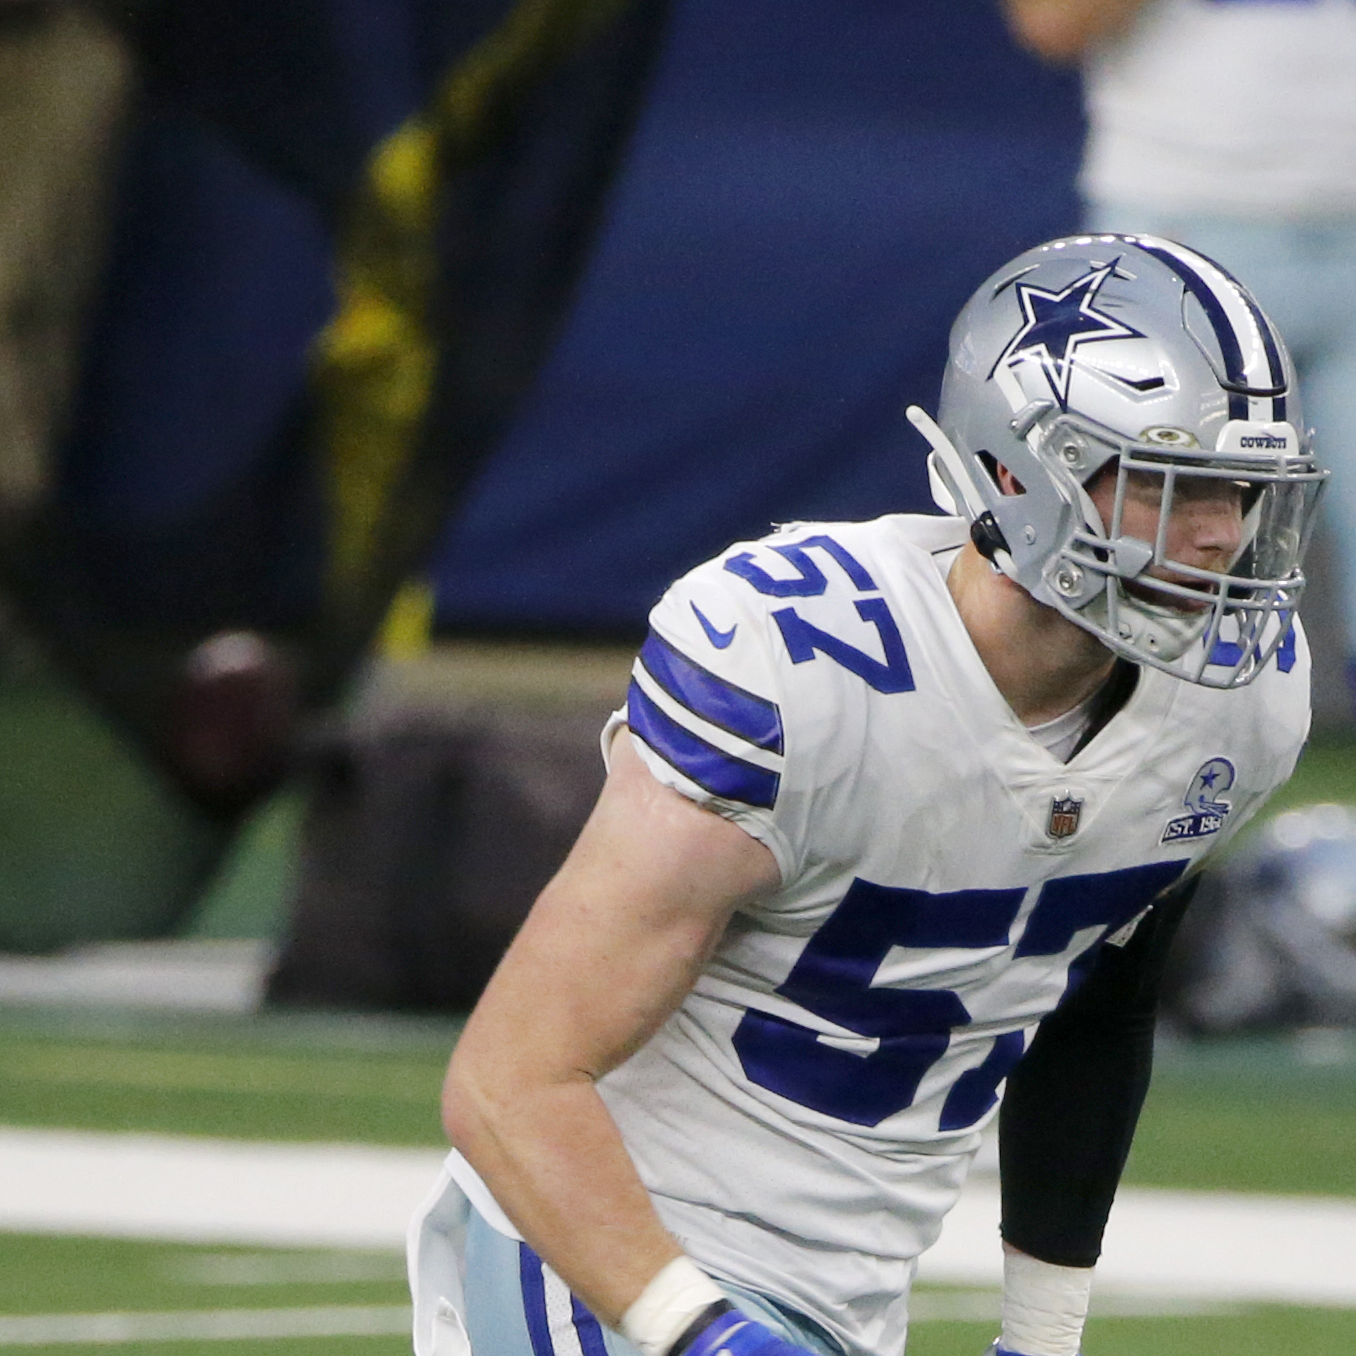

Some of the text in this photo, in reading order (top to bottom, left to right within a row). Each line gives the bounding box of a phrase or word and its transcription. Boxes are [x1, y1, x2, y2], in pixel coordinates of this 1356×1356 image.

[1240, 435, 1288, 450] COWBOYS
[723, 534, 916, 695] 57
[731, 857, 1191, 1133] 57
